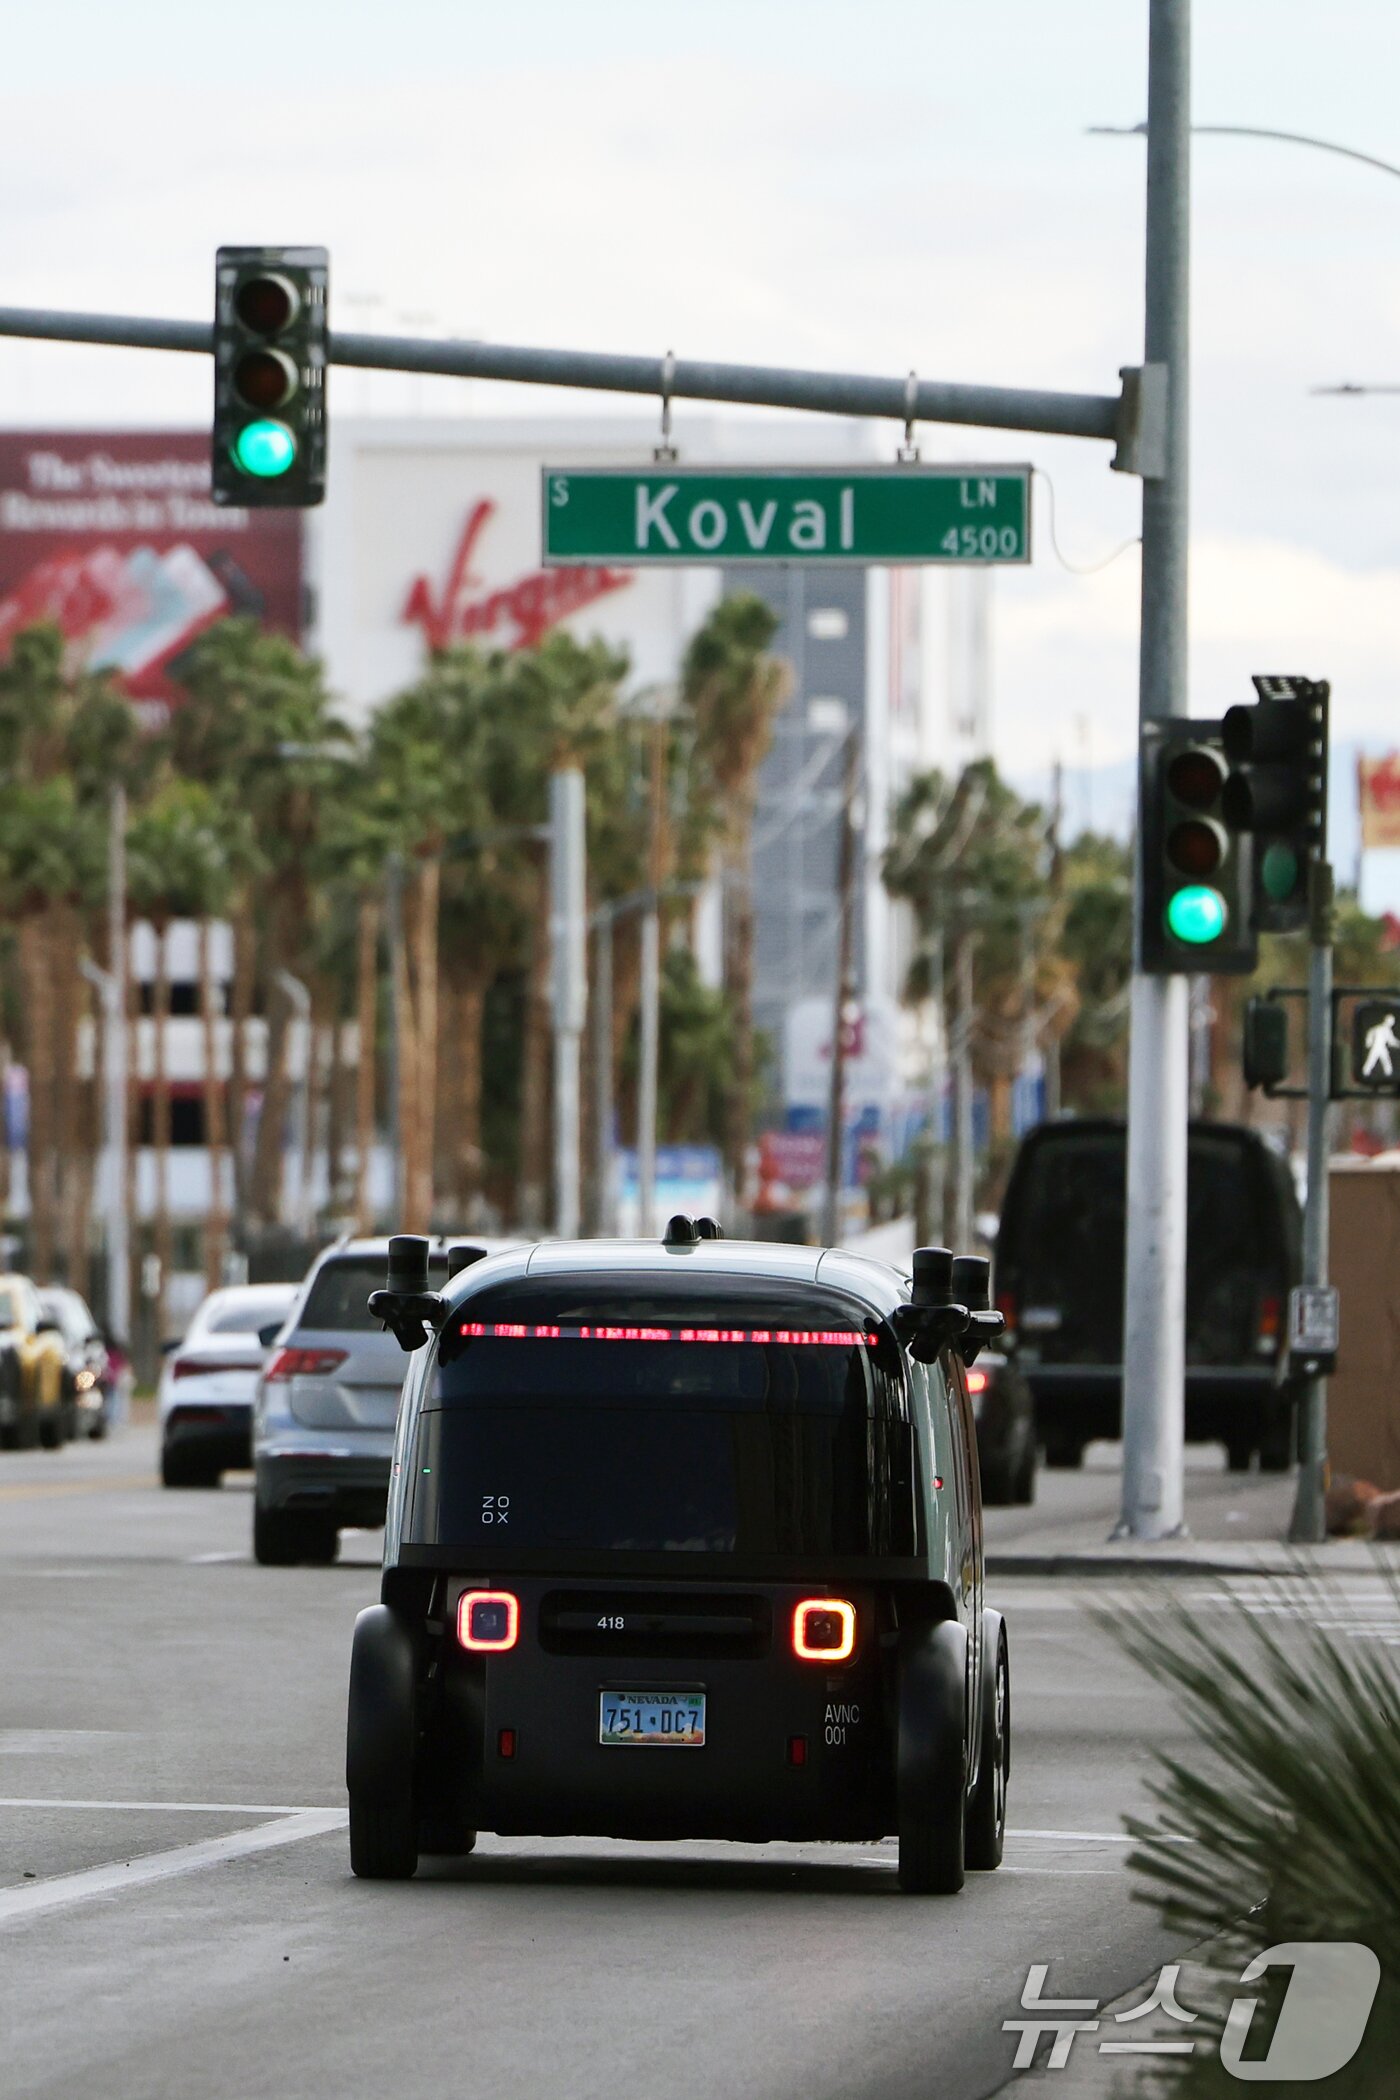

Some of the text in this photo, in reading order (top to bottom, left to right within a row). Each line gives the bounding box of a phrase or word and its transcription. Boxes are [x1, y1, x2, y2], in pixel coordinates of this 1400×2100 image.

[552, 477, 997, 550] S Koval LN
[940, 526, 1018, 558] 4500
[597, 1616, 625, 1630] 418
[626, 1695, 679, 1705] NEVADA
[824, 1704, 860, 1723] AVNC
[824, 1725, 846, 1745] 001
